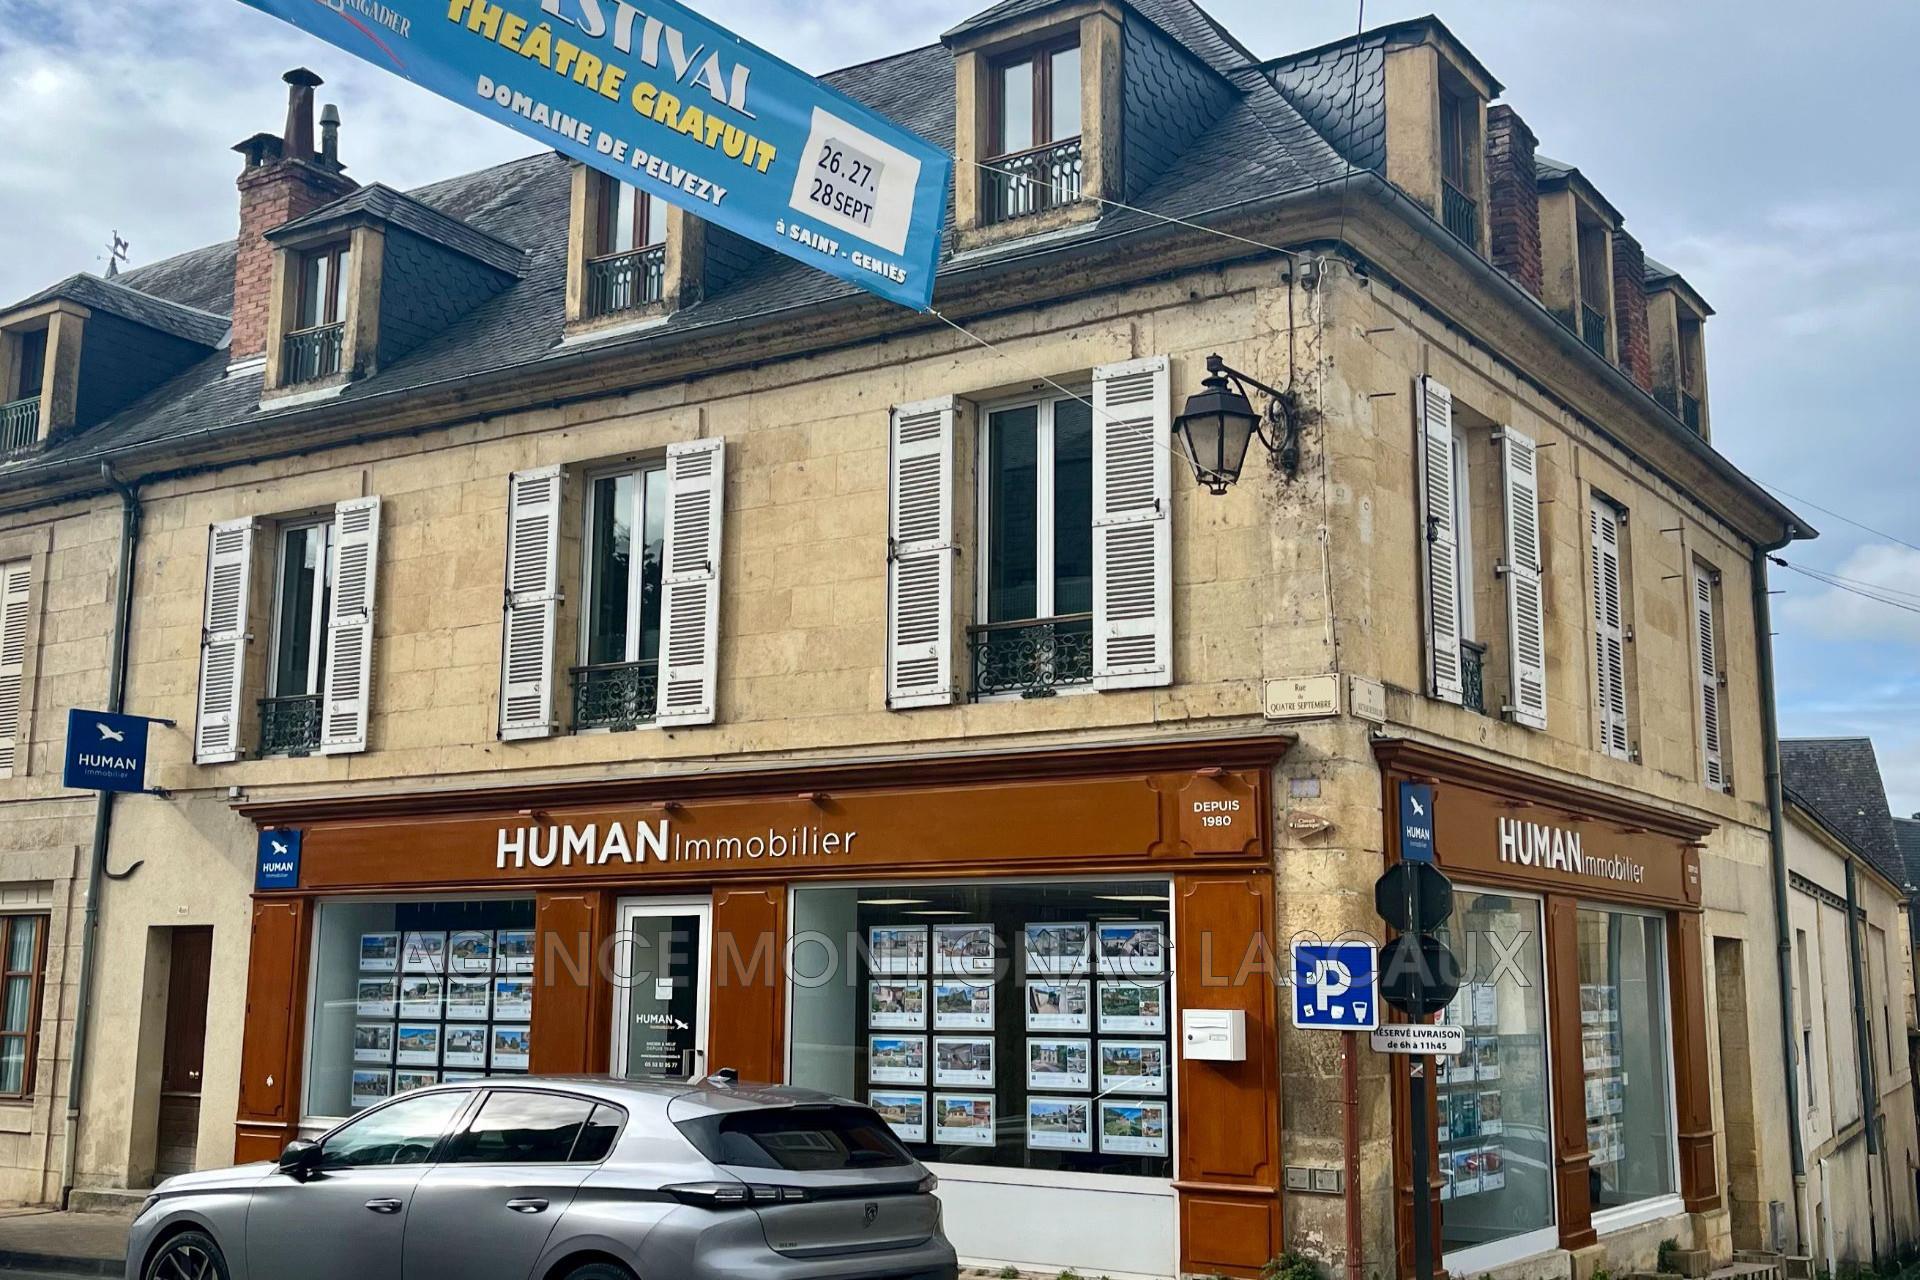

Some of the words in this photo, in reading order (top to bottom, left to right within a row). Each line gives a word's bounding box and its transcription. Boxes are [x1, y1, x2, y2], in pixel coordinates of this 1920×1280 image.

[631, 82, 776, 173] GRATUIT
[477, 74, 593, 146] DOMAINE
[596, 131, 629, 163] DE
[631, 148, 728, 207] PELVEZY
[1294, 683, 1307, 692] Rue
[1270, 702, 1296, 713] QUATRE
[1297, 700, 1332, 711] SEPTEMBRE
[78, 753, 137, 771] HUMAN
[1193, 800, 1240, 813] DEPUIS
[1202, 815, 1232, 828] 1980
[1406, 825, 1430, 841] HUMAN
[496, 819, 671, 869] HUMAN
[675, 826, 856, 862] Immobilier
[1499, 816, 1582, 874] HUMAN
[1581, 847, 1645, 884] Immobilier
[262, 861, 294, 873] HUMAN
[636, 1013, 673, 1024] HUMAN
[1412, 1030, 1461, 1039] LIVRAISON
[1387, 1041, 1398, 1049] de
[1400, 1041, 1411, 1049] 6h
[1420, 1041, 1447, 1050] 11h45
